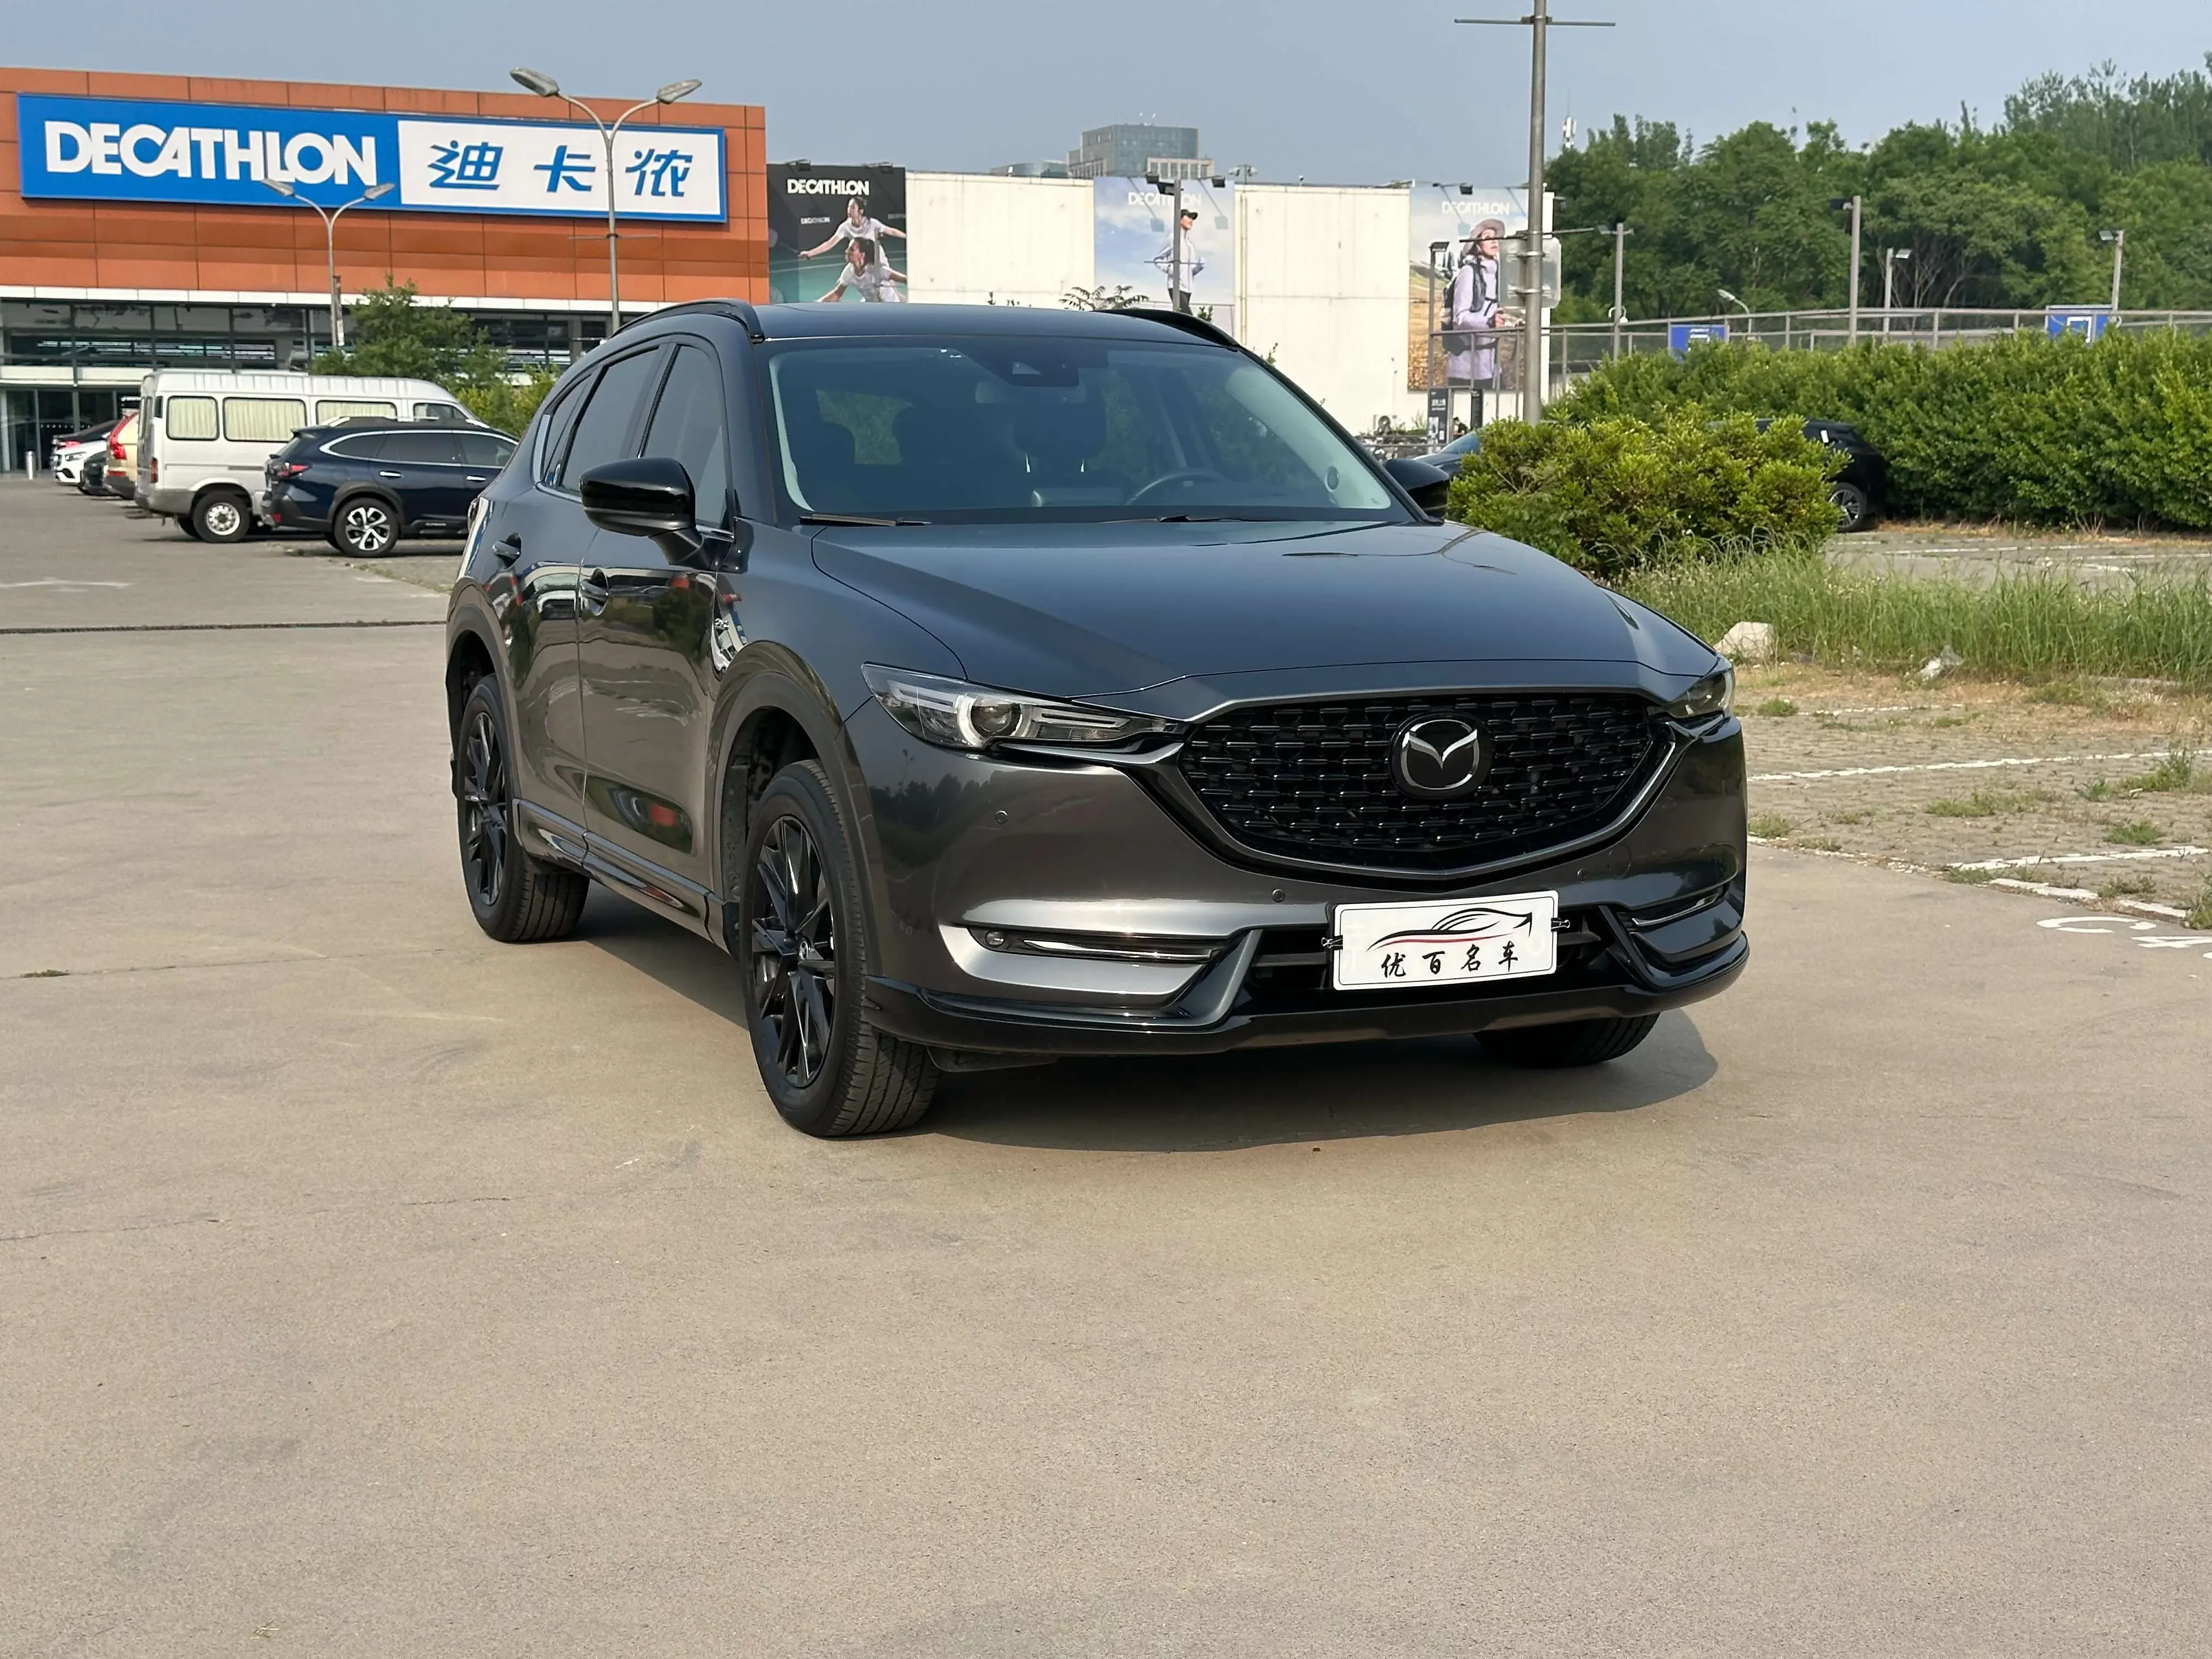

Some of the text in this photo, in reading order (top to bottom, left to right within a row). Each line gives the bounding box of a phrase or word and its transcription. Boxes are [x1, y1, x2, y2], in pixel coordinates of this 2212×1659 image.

[45, 121, 377, 186] DECATHLON
[428, 140, 693, 197] 迪卡侬
[787, 179, 870, 195] DECATHLON
[1128, 191, 1202, 206] DECATON
[1441, 201, 1510, 216] DECATHLON
[1381, 940, 1519, 979] 优百名车
